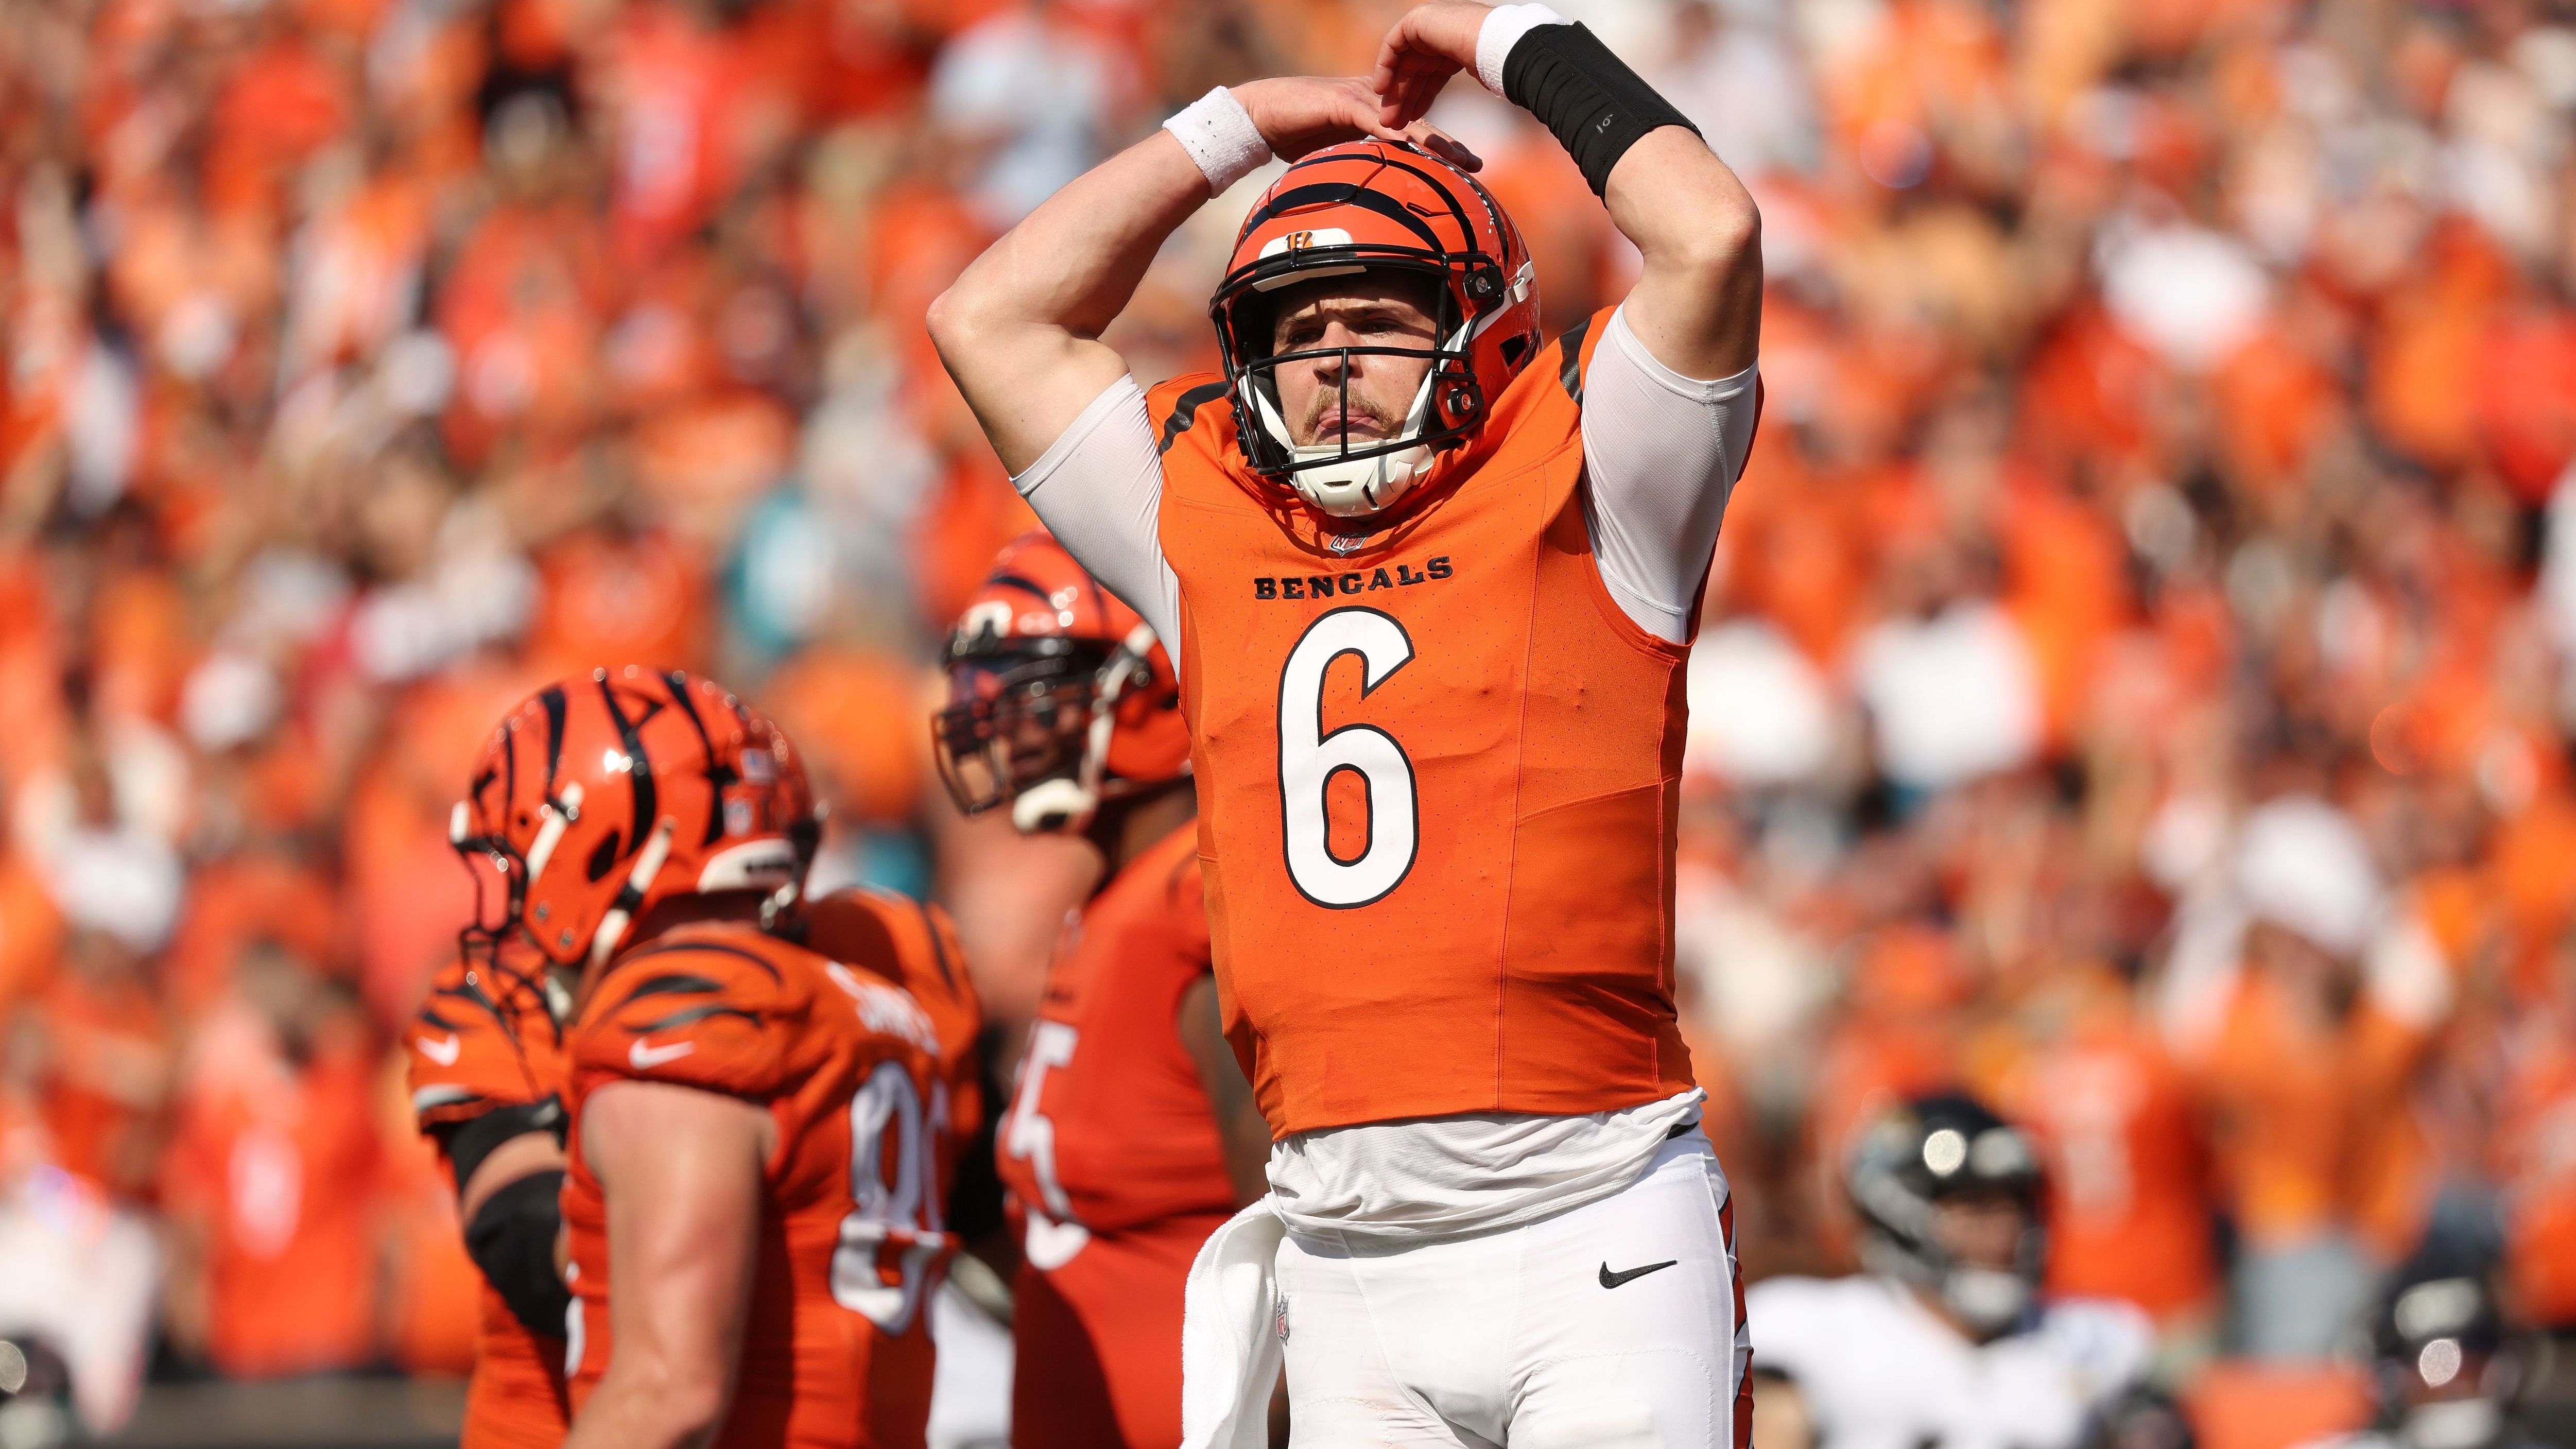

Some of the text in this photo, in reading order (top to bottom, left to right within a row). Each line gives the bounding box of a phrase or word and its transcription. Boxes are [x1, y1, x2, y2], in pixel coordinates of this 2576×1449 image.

[1254, 556, 1454, 600] BENGALS
[1277, 606, 1420, 910] 6
[829, 1060, 948, 1337] 8
[998, 1019, 1092, 1270] 5
